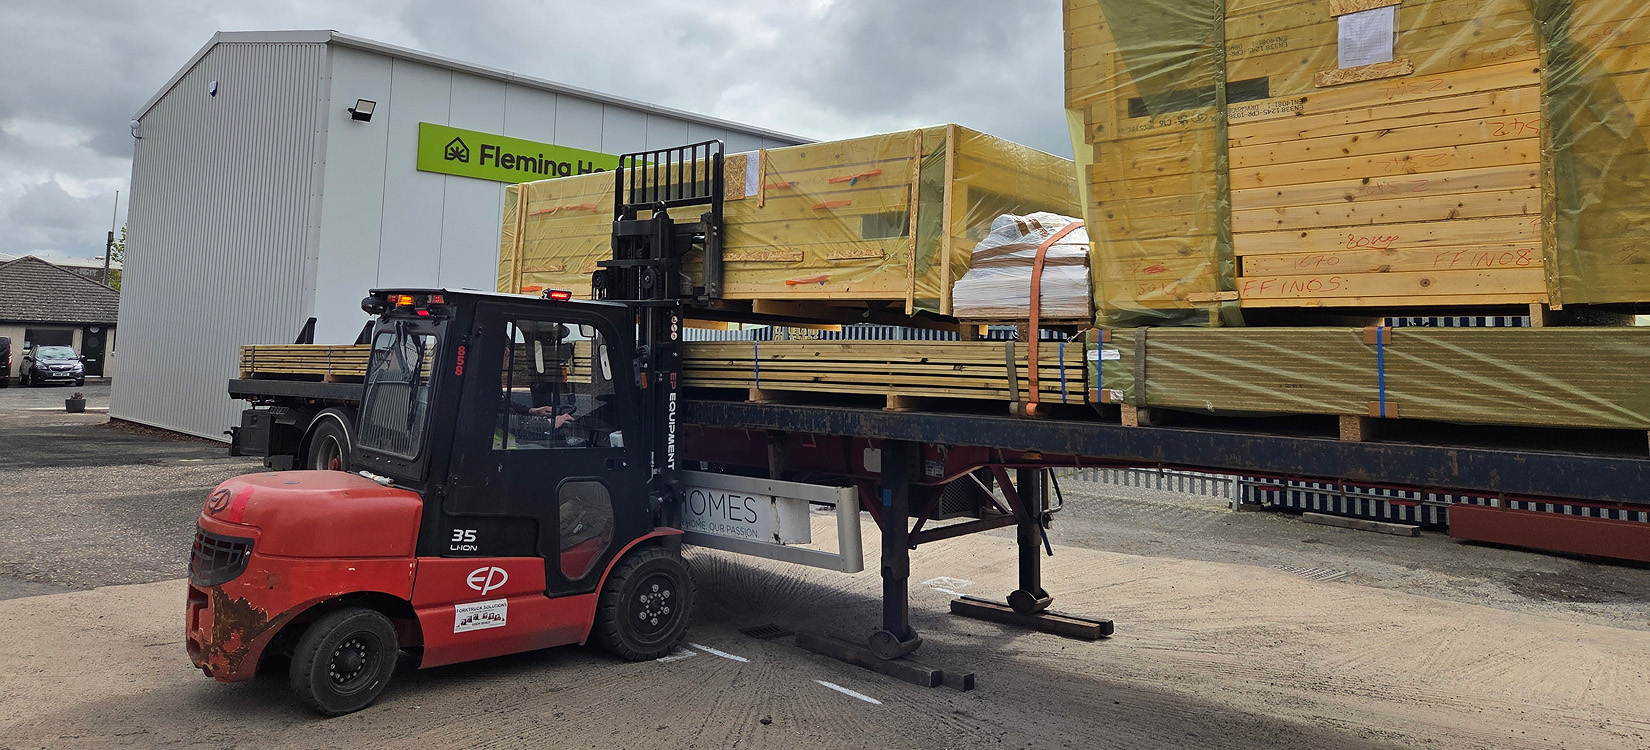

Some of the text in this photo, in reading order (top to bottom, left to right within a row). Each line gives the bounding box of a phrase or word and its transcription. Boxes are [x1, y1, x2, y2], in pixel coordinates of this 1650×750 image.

[479, 143, 572, 177] Fleming
[454, 345, 466, 376] 858
[667, 392, 677, 471] EQUIPMENT
[451, 528, 478, 543] 35
[466, 566, 509, 596] EP
